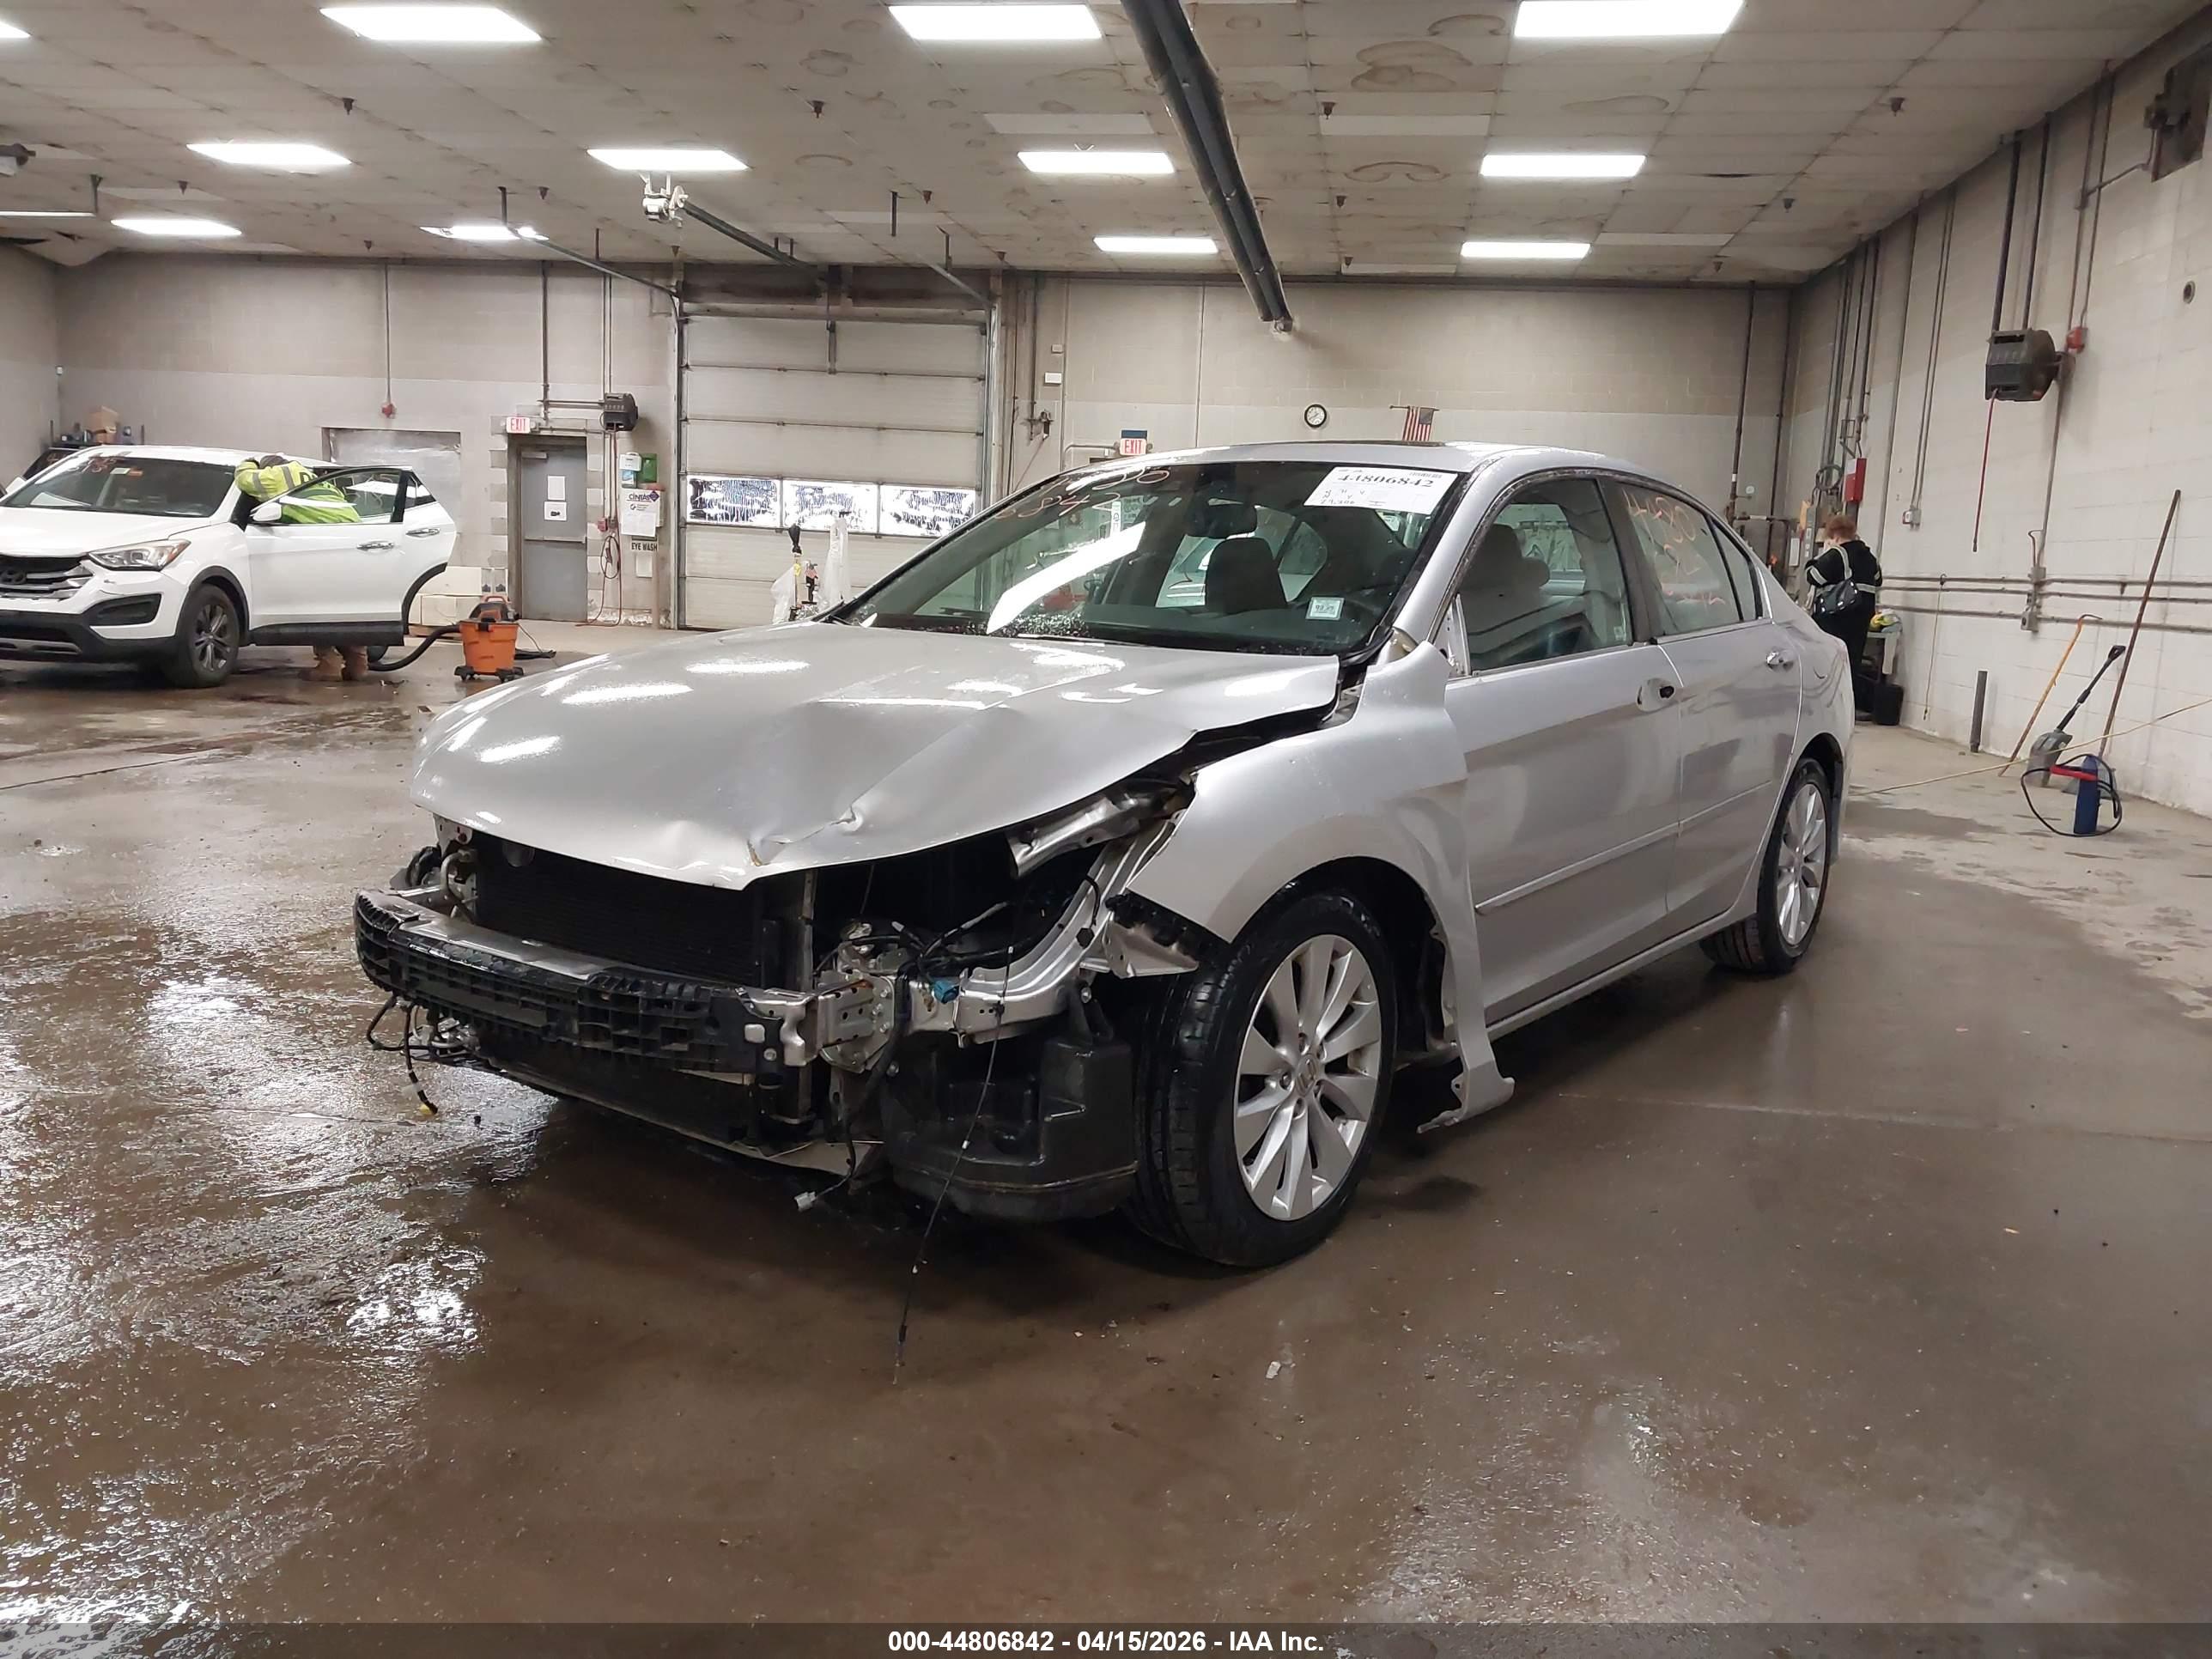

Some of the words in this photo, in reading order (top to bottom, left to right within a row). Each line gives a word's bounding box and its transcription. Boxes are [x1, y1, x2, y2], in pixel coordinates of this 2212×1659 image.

[510, 418, 526, 431] EXIT
[1124, 439, 1142, 453] EXIT
[1337, 473, 1434, 488] 44806842
[628, 492, 650, 501] CINTAS
[642, 542, 658, 551] WASH
